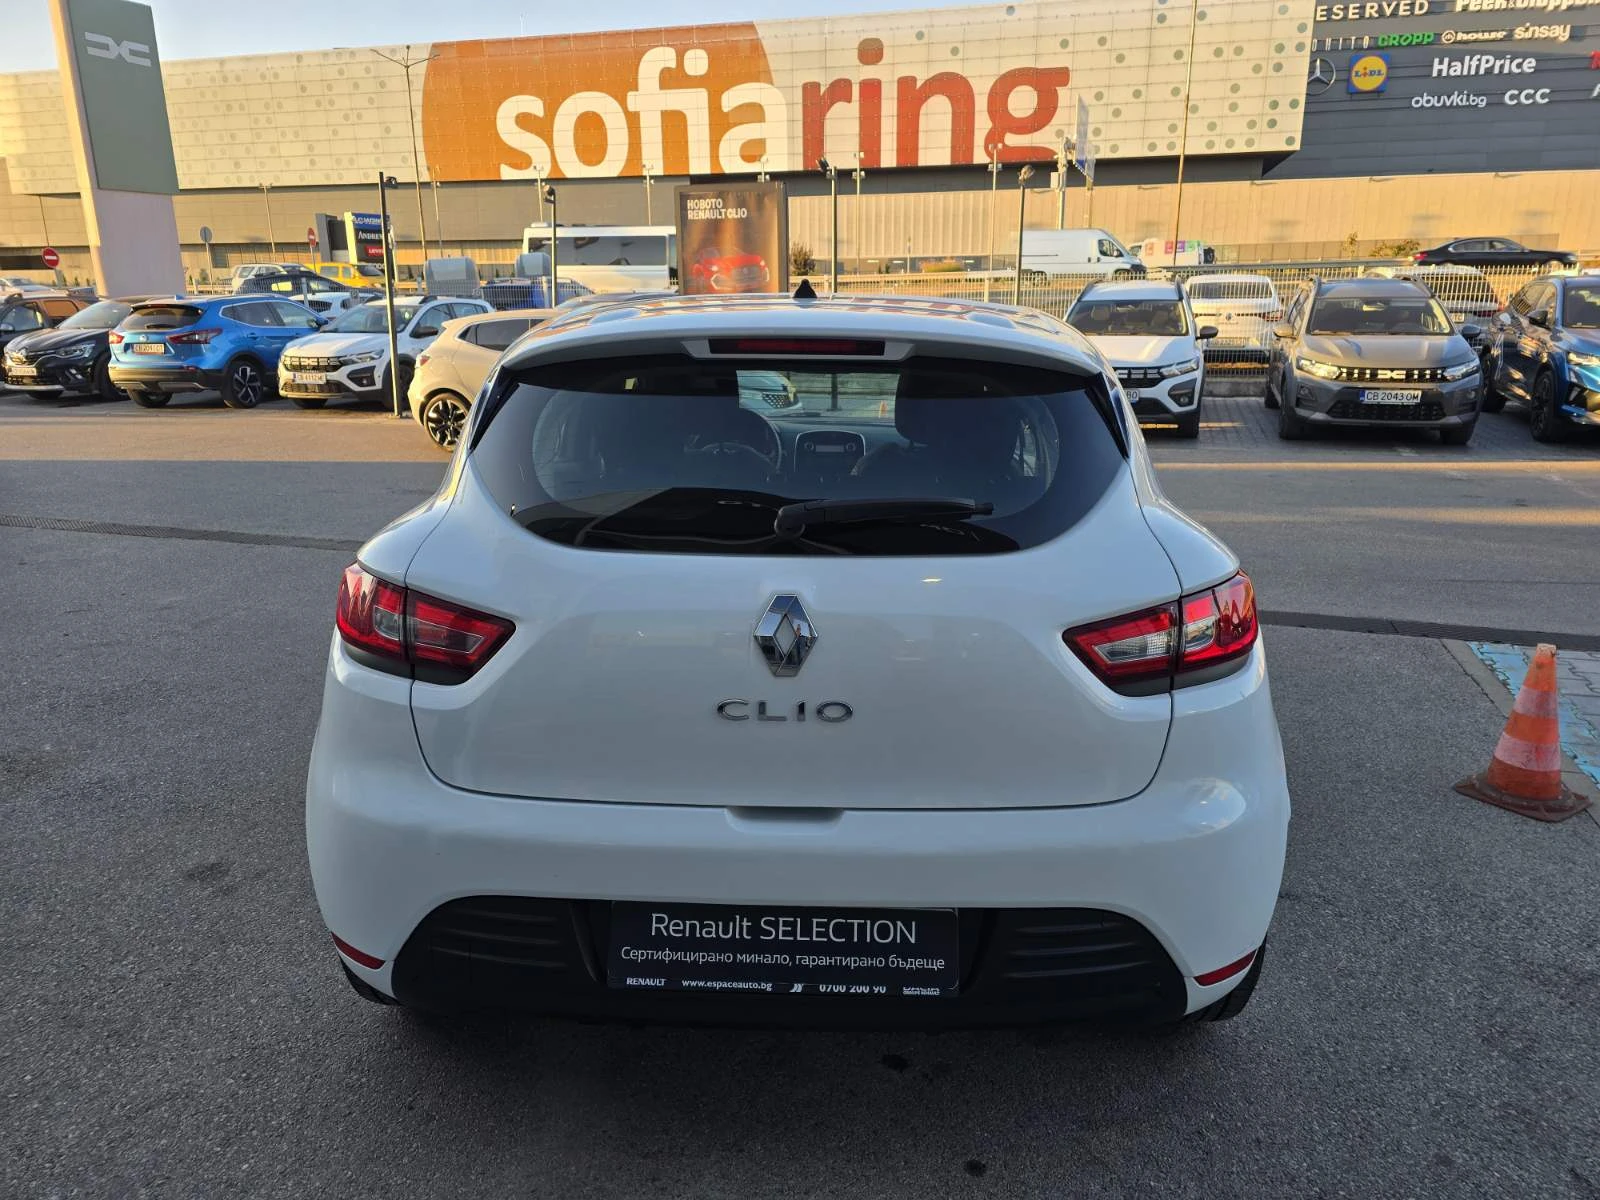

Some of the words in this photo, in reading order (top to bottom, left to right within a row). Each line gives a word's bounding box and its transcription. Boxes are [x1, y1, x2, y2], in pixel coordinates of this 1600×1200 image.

[1513, 22, 1571, 41] sinsay
[1432, 54, 1537, 77] HalfPrice
[1411, 91, 1487, 108] obuvki.bg
[1504, 88, 1550, 105] CCC
[687, 209, 726, 220] RENAULT
[726, 208, 748, 219] CLIO
[1366, 391, 1379, 401] CB
[1381, 392, 1404, 401] 2043
[1406, 392, 1419, 401] OM
[717, 698, 853, 723] CLIO
[651, 913, 752, 939] Renault
[760, 917, 916, 944] SELECTION
[621, 946, 733, 965] Сертифицирано
[736, 953, 793, 967] минало,
[796, 955, 885, 970] гарантирано
[888, 955, 945, 972] бъдеще
[626, 977, 667, 987] RENAULT
[682, 979, 773, 992] www.espaceauto.bg
